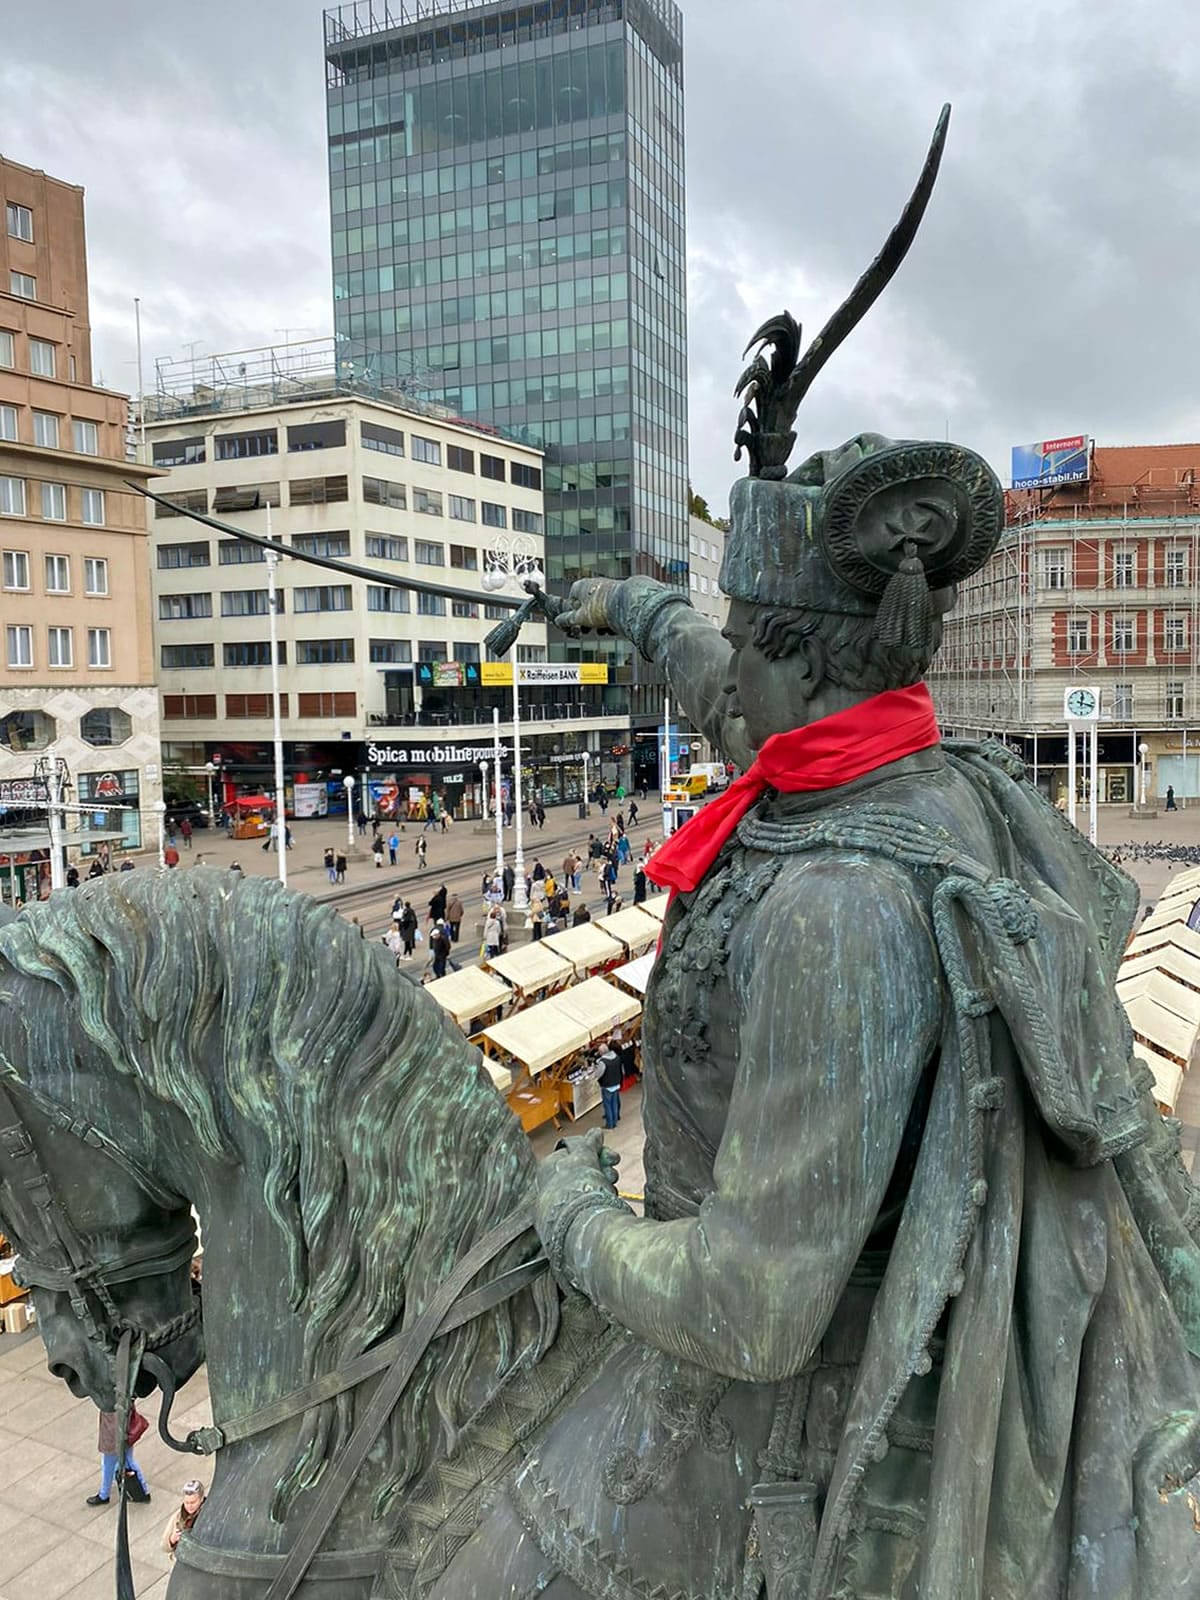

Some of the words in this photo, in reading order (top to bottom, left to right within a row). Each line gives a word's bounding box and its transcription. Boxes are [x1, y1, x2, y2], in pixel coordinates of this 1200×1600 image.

[1014, 471, 1083, 488] hoco-stabil.hr
[526, 669, 558, 680] Raiffeisen
[559, 670, 578, 680] BANK
[368, 743, 407, 765] Špica
[410, 746, 472, 763] mobilne
